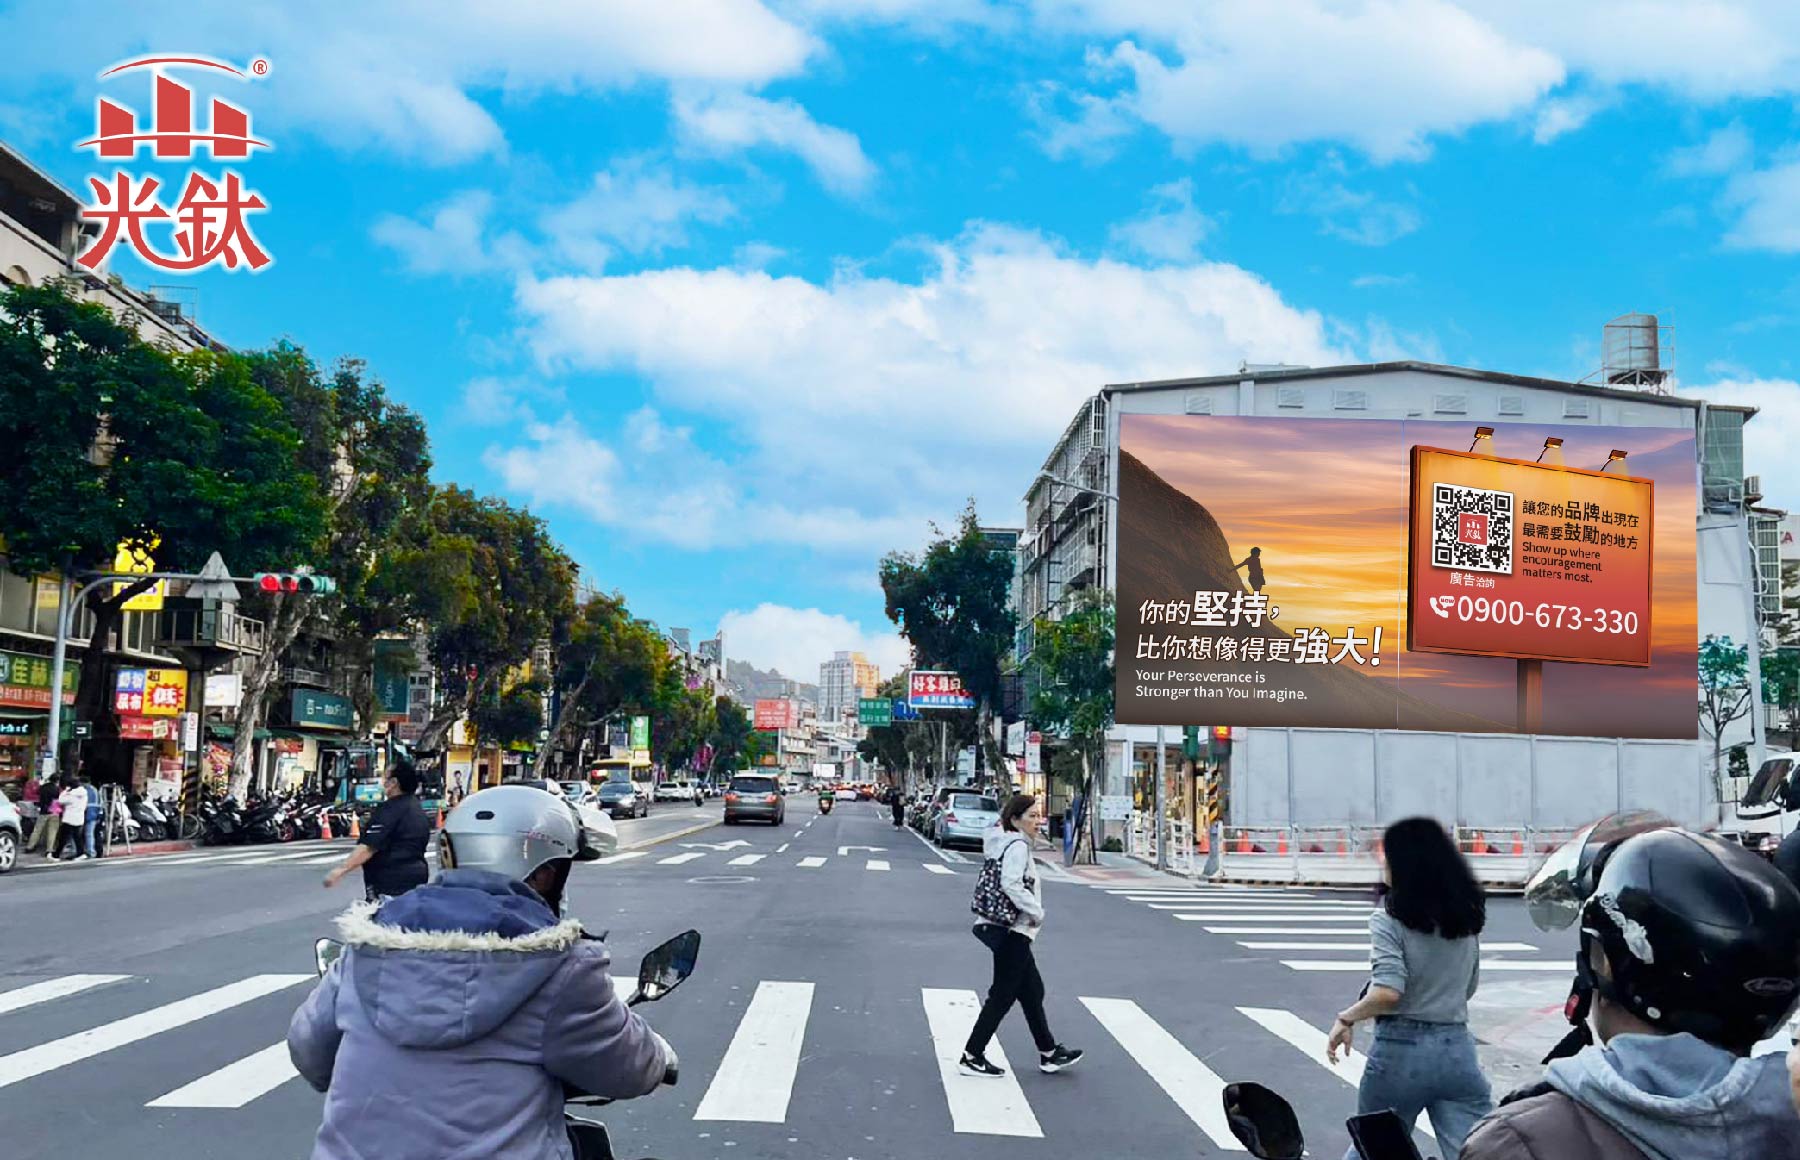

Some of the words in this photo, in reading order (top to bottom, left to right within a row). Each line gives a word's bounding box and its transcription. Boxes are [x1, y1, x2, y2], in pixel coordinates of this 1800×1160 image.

[1522, 500, 1639, 528] 讓您的品牌出現在
[1522, 522, 1638, 550] 最需要鼓勵的地方
[1522, 542, 1551, 554] Show
[1554, 545, 1567, 557] up
[1570, 547, 1601, 560] where
[1522, 555, 1602, 572] encouragement
[1450, 572, 1496, 588] 廣告洽詢
[1522, 568, 1562, 580] matters
[1564, 572, 1593, 584] most.
[1457, 595, 1638, 634] 0900-673-330
[1135, 626, 1383, 667] 比你想像得更強大!
[1136, 669, 1165, 682] Your
[1168, 670, 1252, 684] Perseverance
[1255, 671, 1266, 683] is
[1136, 685, 1192, 700] Stronger
[1194, 686, 1223, 699] than
[1226, 687, 1249, 699] You
[1253, 688, 1308, 703] Imagine.
